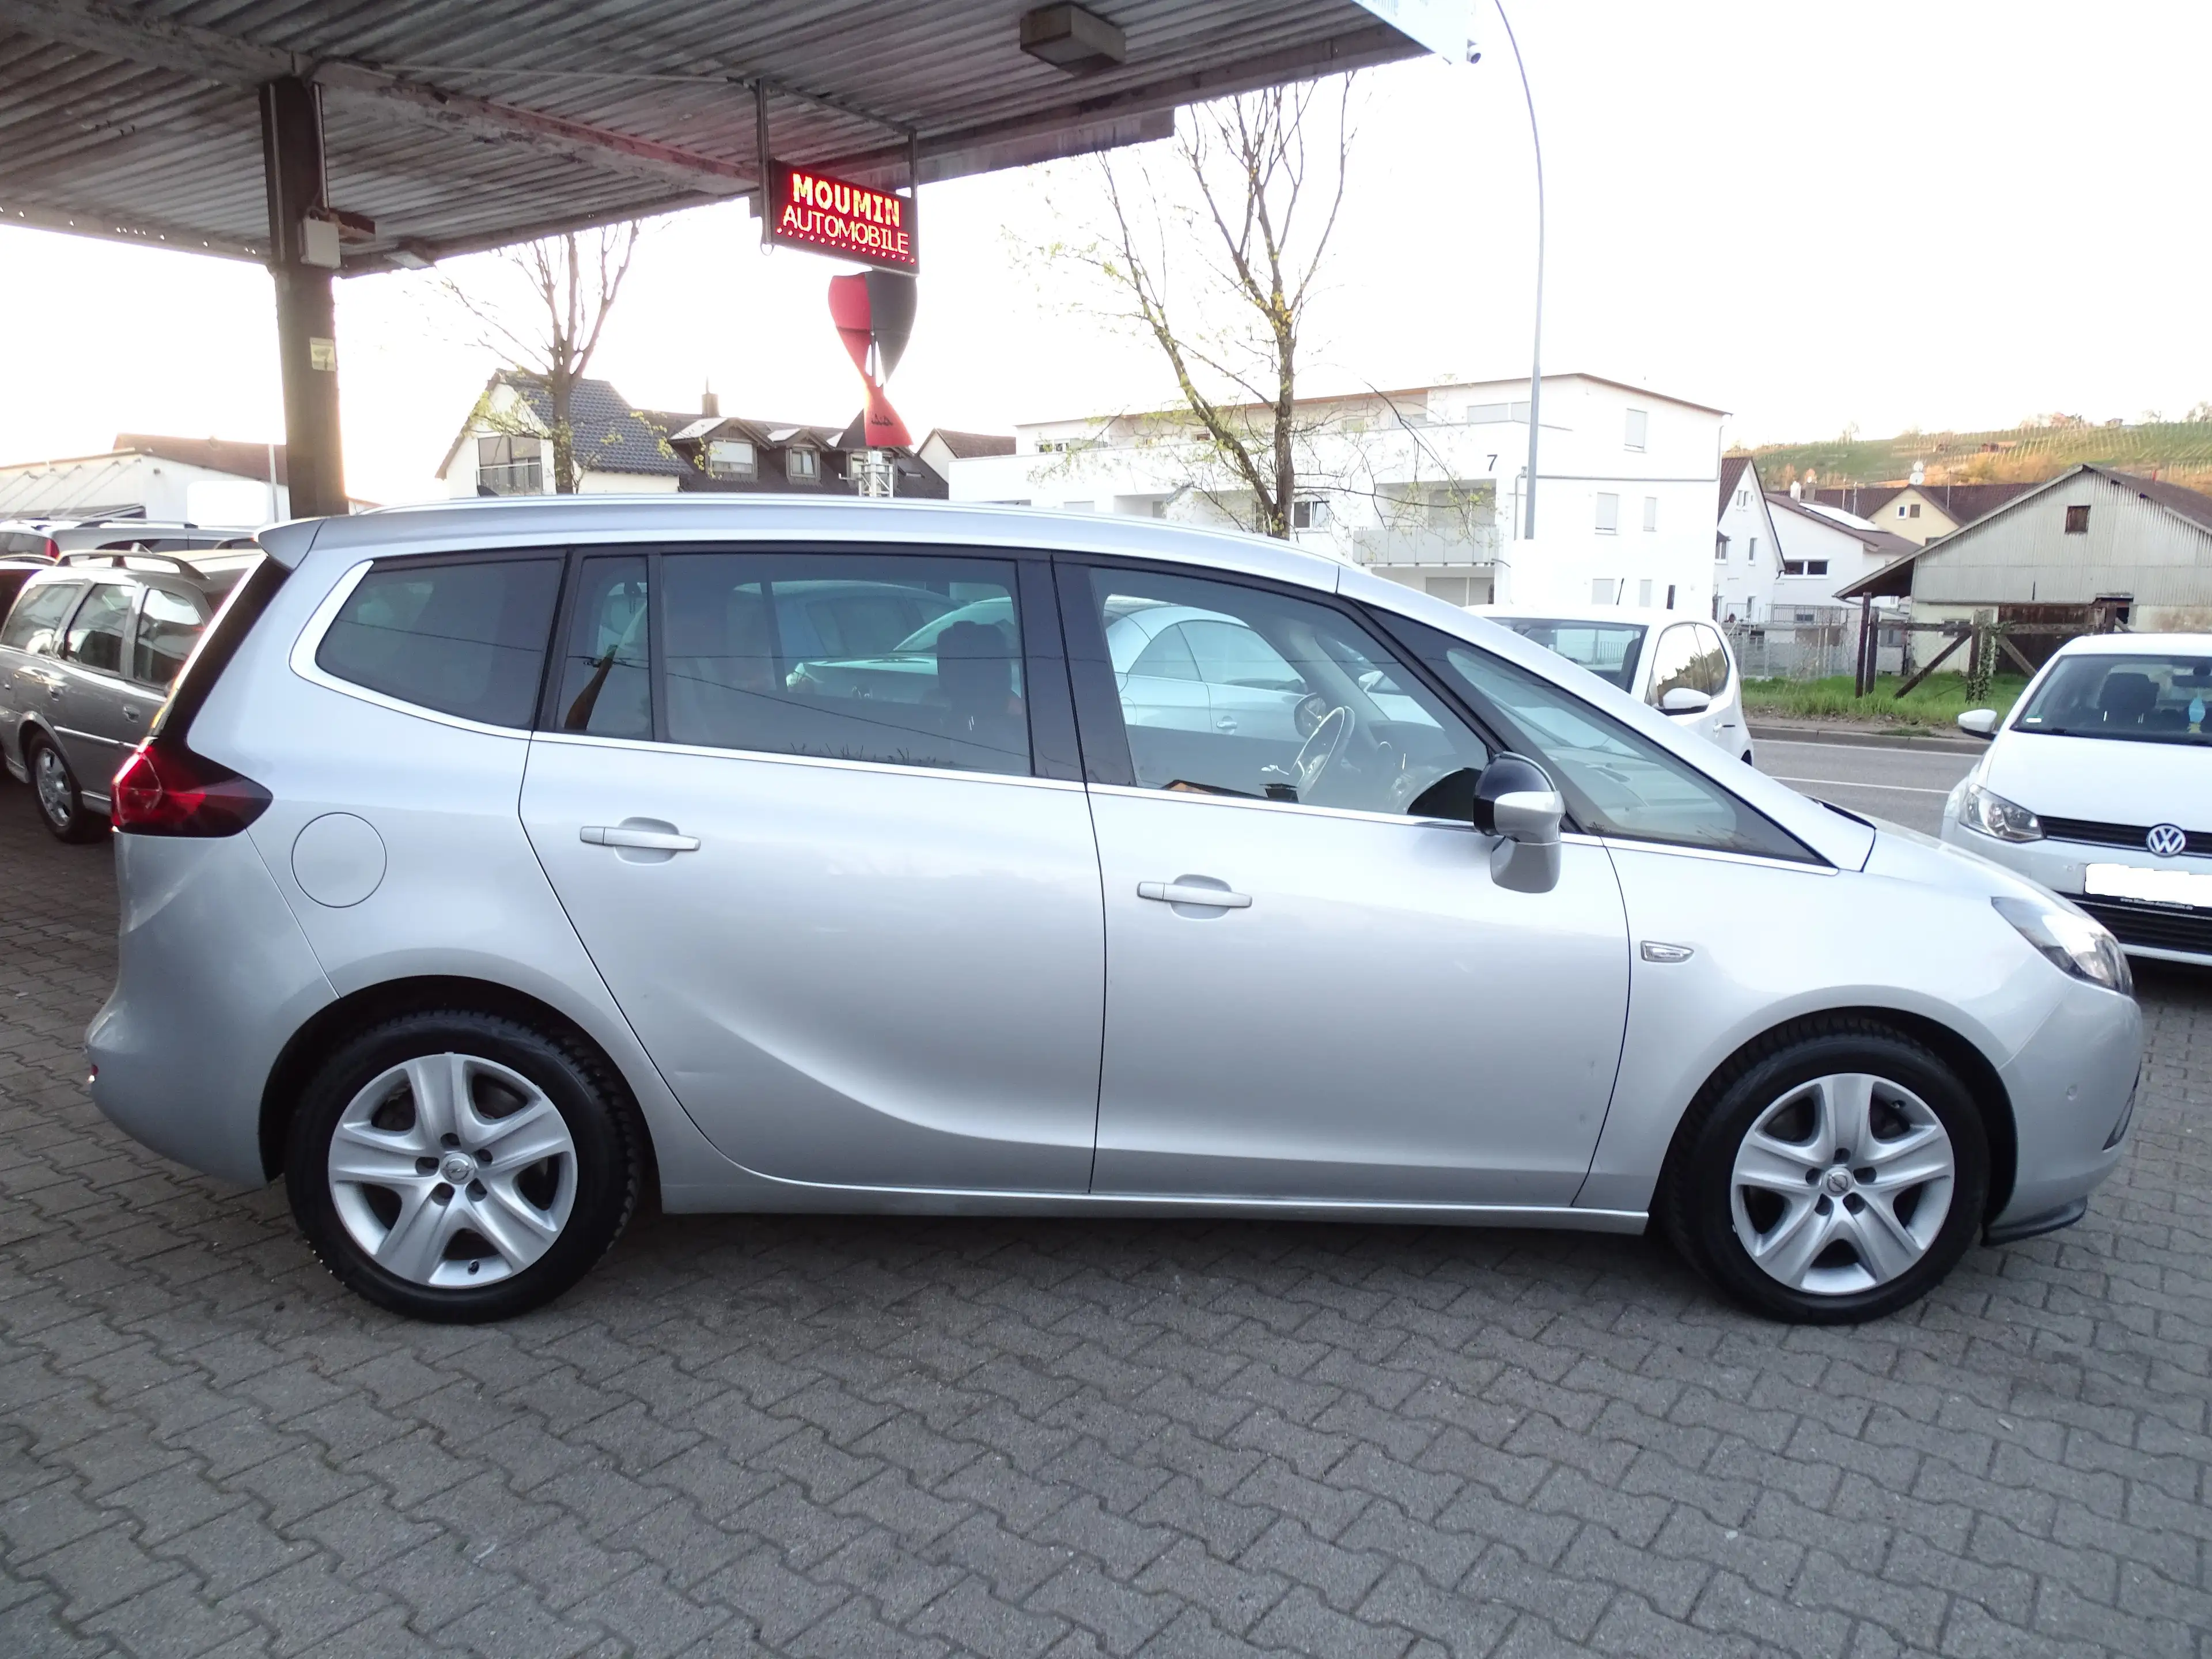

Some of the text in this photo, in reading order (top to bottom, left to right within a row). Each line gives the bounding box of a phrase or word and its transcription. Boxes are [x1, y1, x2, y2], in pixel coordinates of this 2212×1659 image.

[793, 173, 900, 228] MOUMIN
[783, 205, 909, 255] AUTOMOBILE
[1487, 454, 1498, 471] 7
